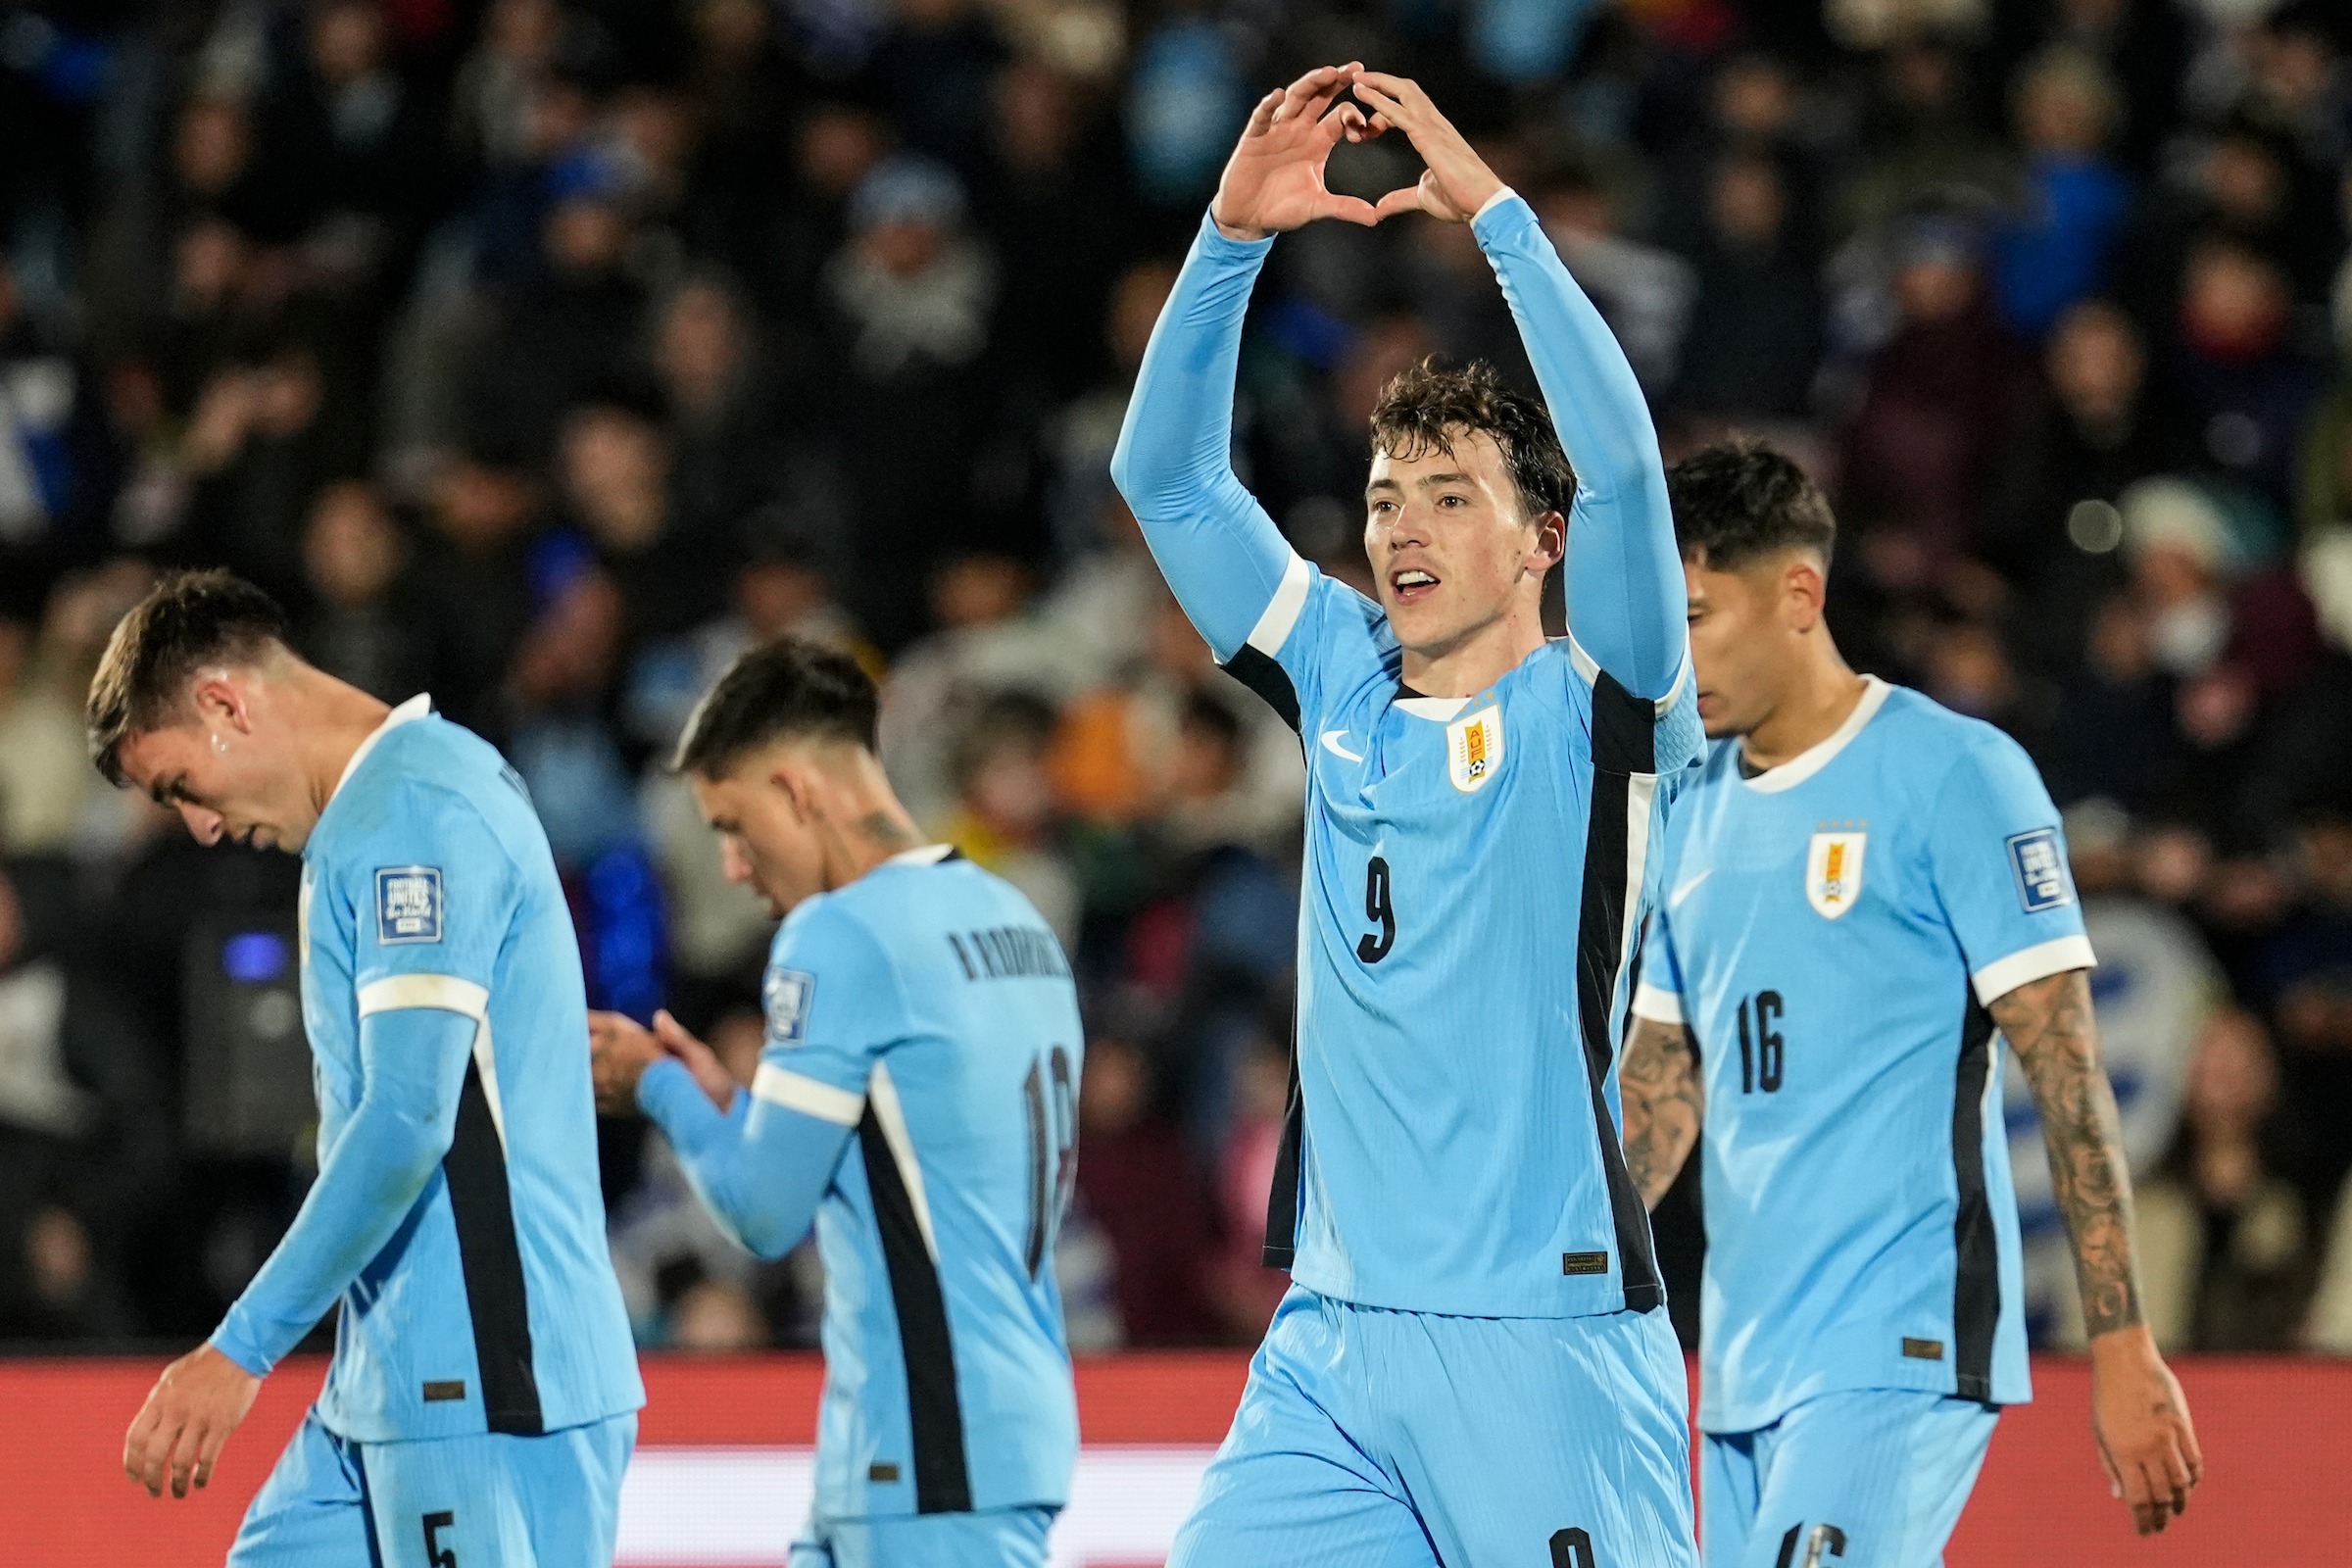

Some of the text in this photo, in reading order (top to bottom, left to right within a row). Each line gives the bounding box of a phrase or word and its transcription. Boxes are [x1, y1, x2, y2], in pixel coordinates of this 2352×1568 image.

[1470, 729, 1483, 760] AUF
[1356, 857, 1396, 963] 9
[1739, 991, 1783, 1094] 16
